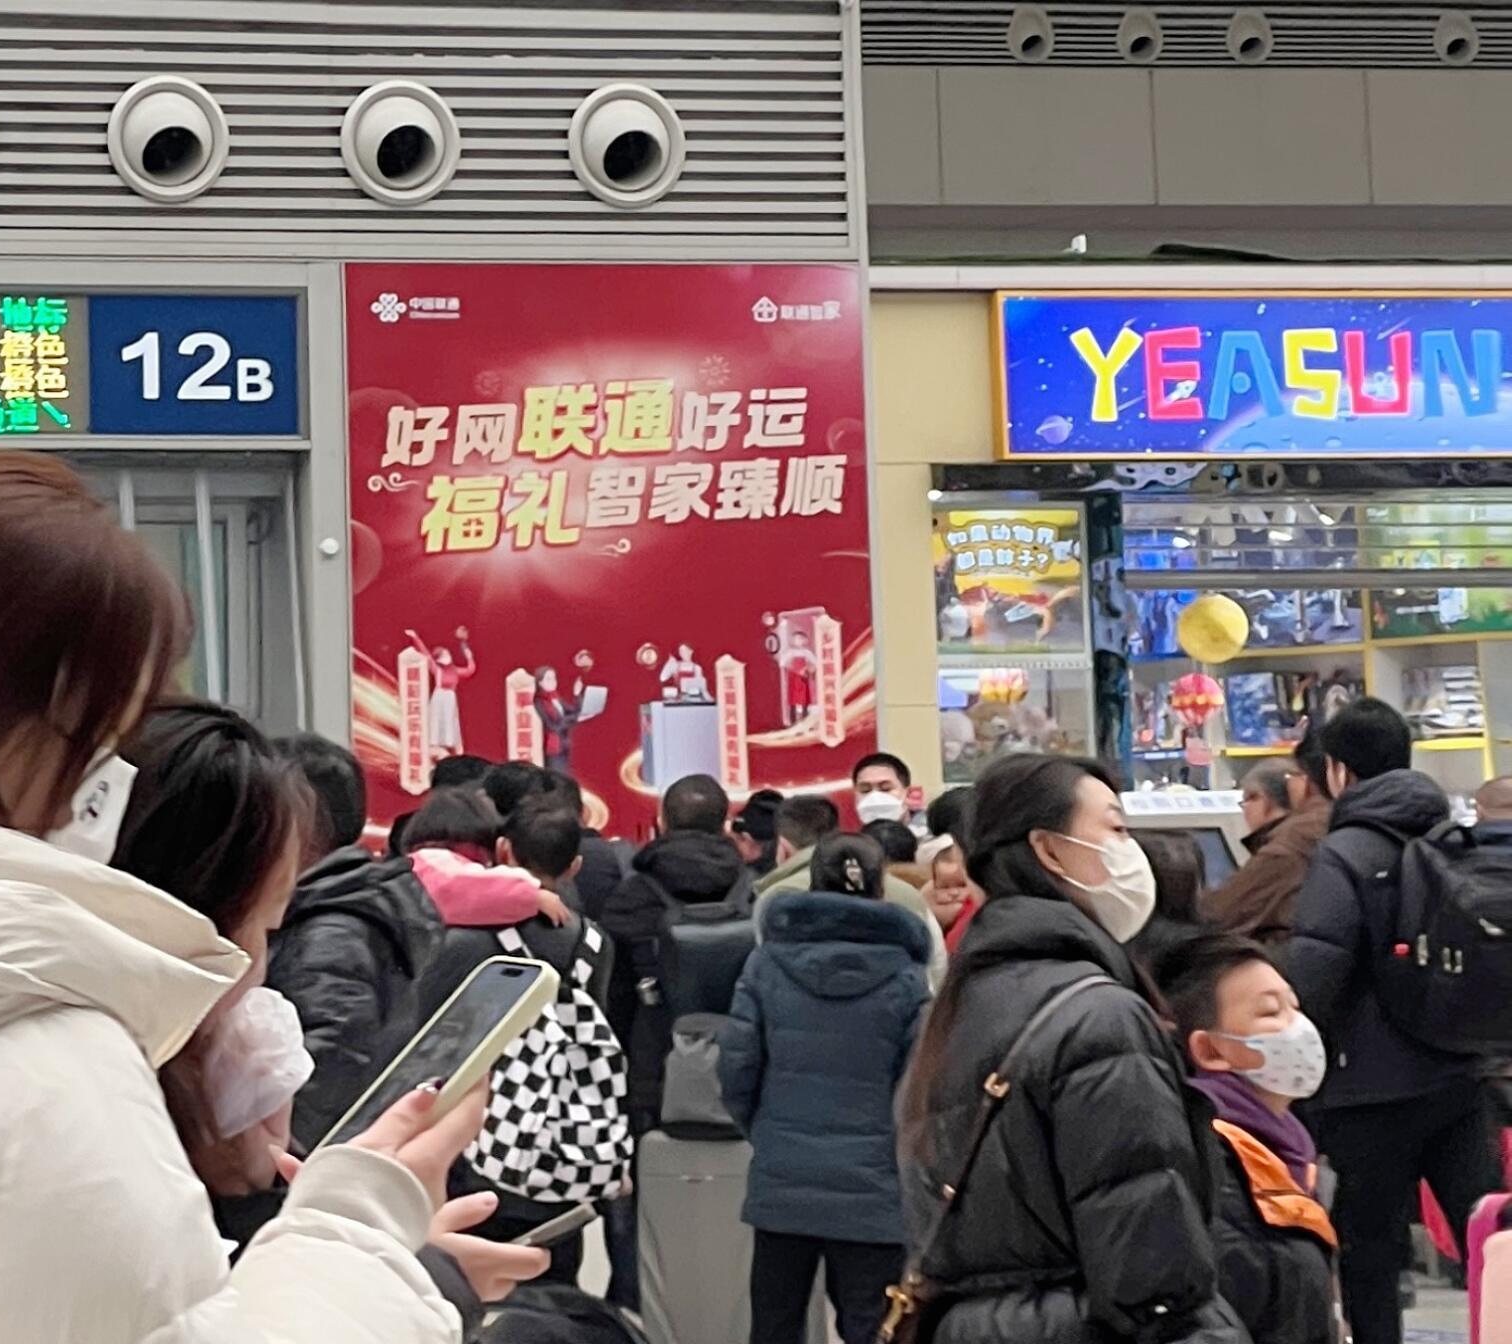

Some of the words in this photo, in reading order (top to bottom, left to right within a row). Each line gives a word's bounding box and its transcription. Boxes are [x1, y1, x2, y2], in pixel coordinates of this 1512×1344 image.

[0, 330, 70, 365] 橙色
[0, 363, 70, 400] 橙色
[121, 331, 274, 402] 12B
[1069, 326, 1502, 422] YEASUN
[381, 379, 807, 470] 好网联通好运
[419, 453, 848, 554] 福礼智家臻顺
